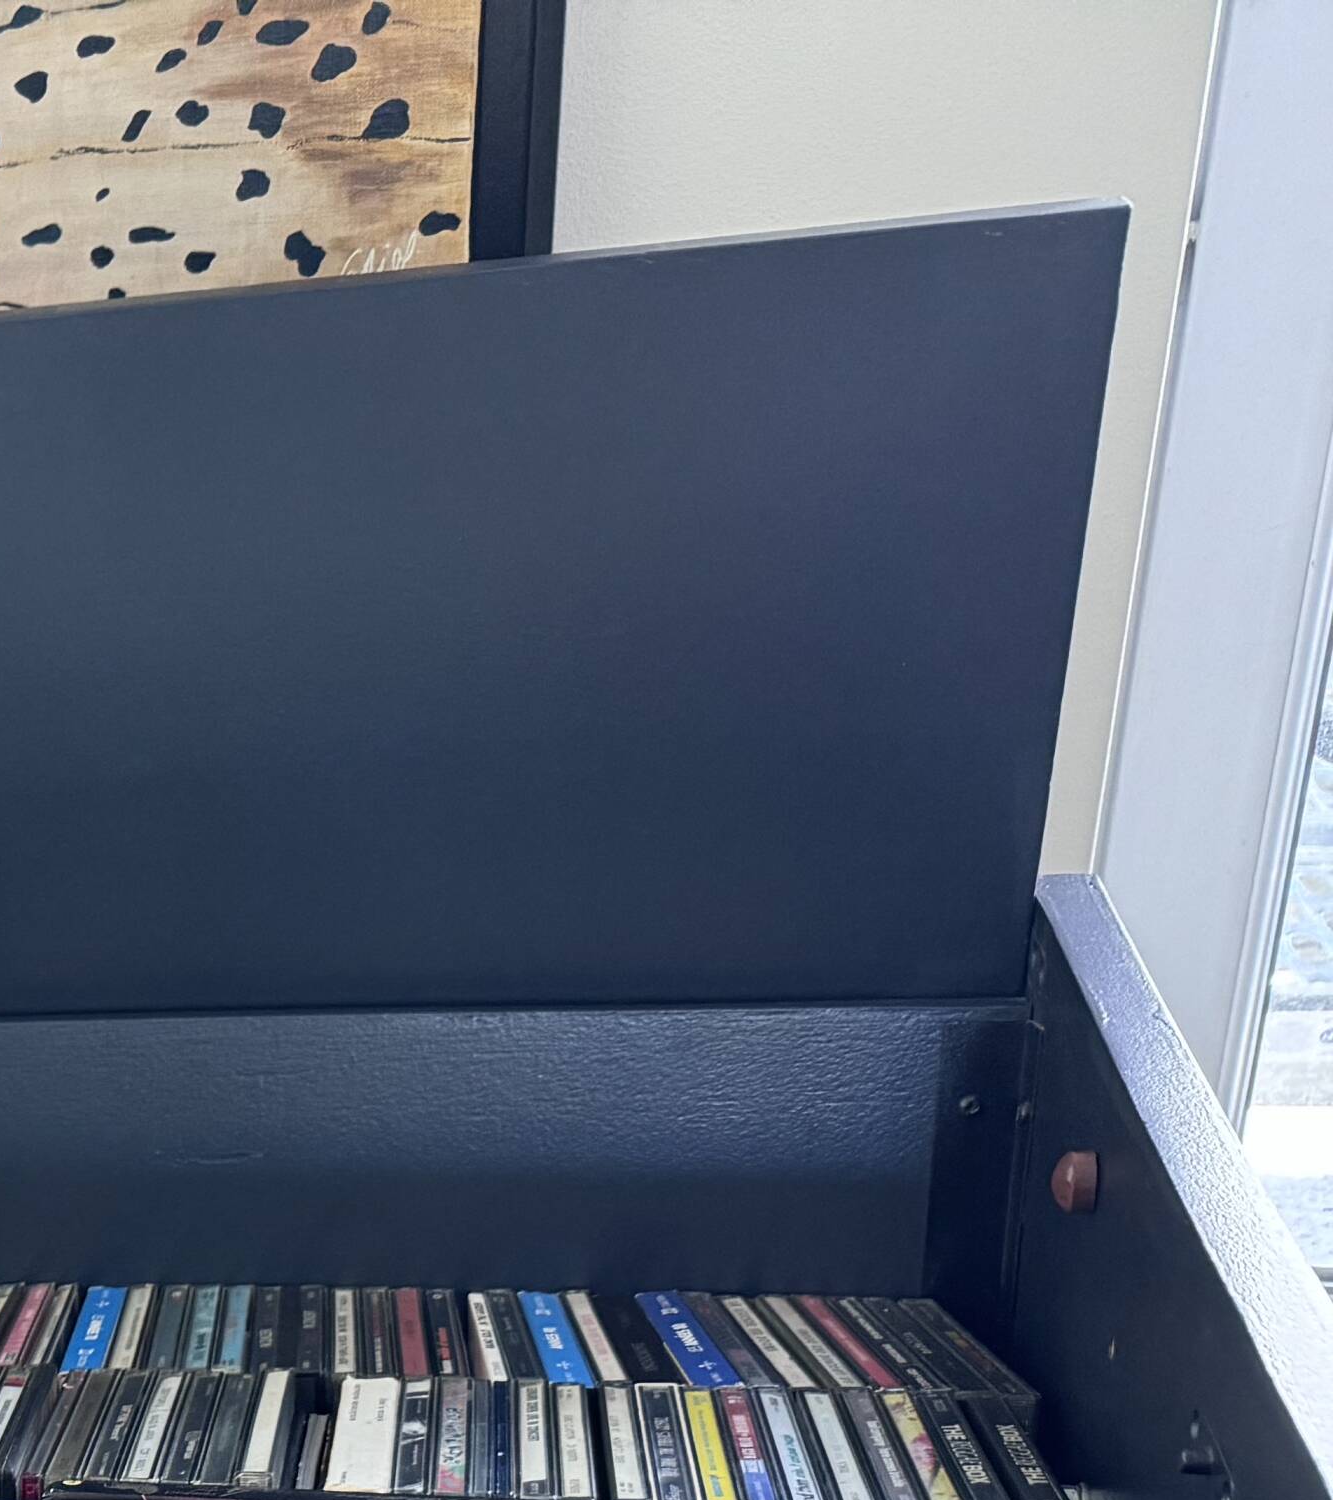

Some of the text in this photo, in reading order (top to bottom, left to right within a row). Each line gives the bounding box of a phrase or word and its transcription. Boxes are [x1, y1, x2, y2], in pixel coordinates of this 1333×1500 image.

[995, 1423, 1023, 1442] BOX
[942, 1423, 966, 1441] THE
[965, 1464, 991, 1484] BOX
[1020, 1466, 1050, 1486] THE
